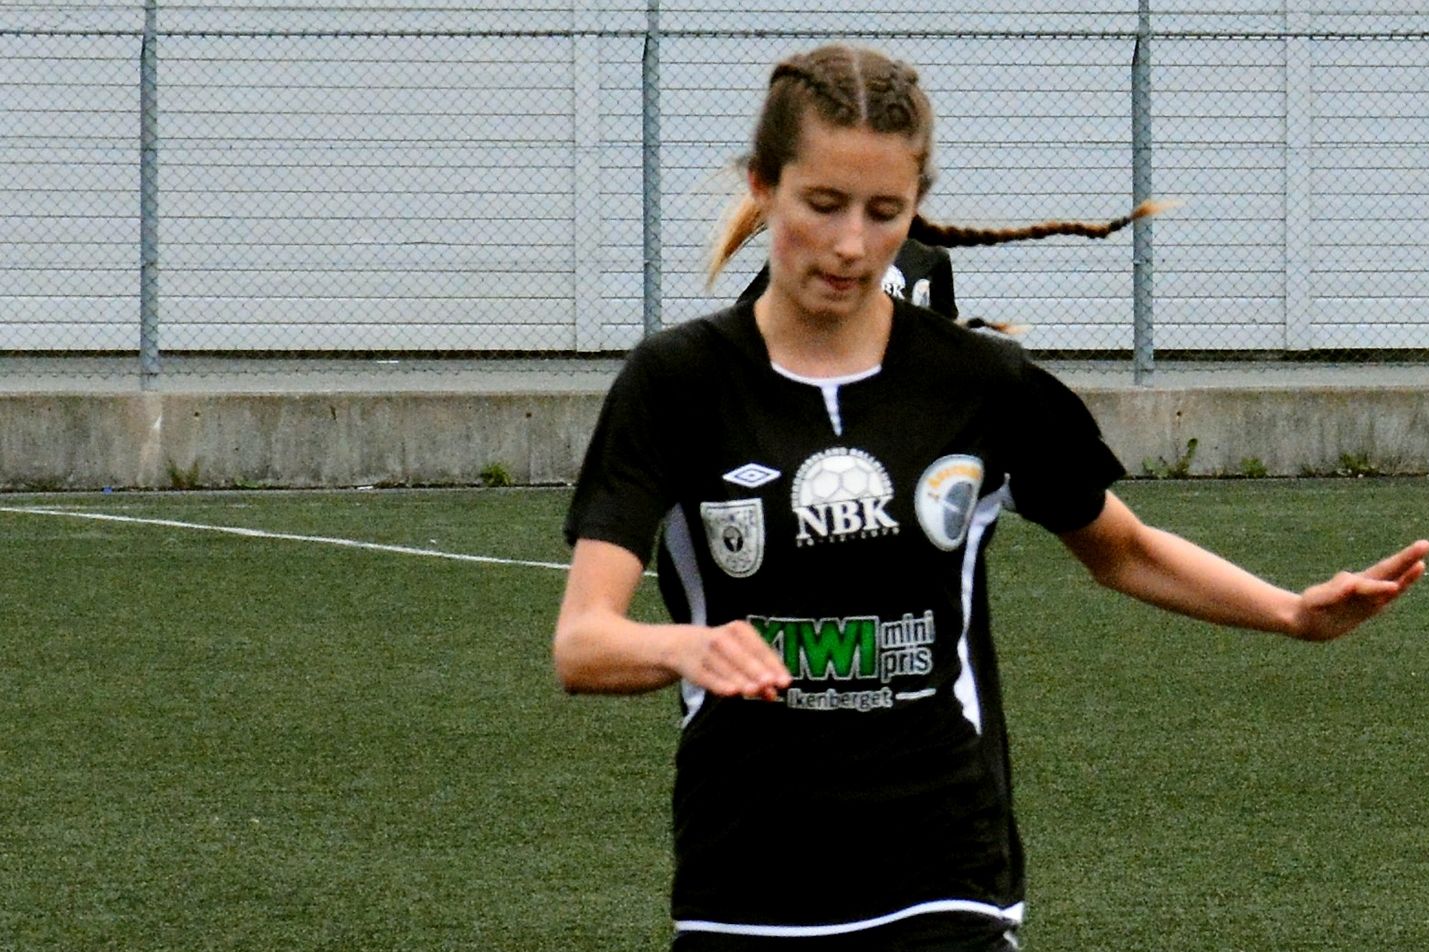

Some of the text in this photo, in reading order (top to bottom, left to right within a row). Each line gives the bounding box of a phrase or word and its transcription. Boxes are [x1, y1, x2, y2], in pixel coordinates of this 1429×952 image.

[792, 495, 899, 540] NBK
[881, 610, 936, 649] mini
[881, 647, 933, 683] pris
